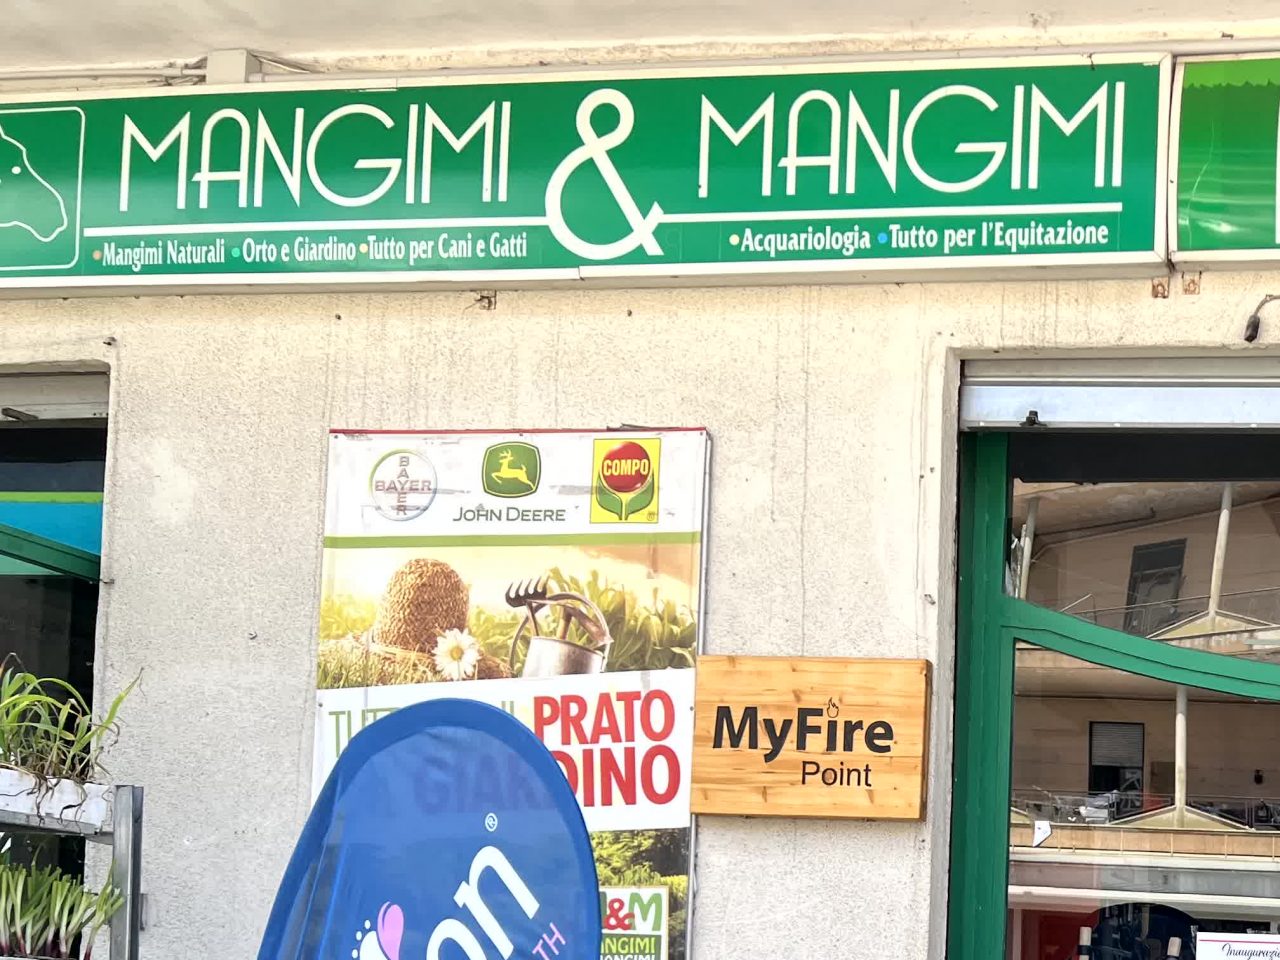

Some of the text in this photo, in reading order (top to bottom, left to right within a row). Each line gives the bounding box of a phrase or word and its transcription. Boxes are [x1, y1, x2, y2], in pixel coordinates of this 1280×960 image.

[119, 81, 1126, 261] MANGIMI & MANGIMI
[102, 231, 527, 272] Mangimi Naturali Orto e Giardino Tutto per Cani e Gatti
[740, 219, 1109, 257] Acquariologia Tutto per l'Equitazione
[375, 480, 432, 492] BAYER
[603, 458, 649, 477] COMPO
[453, 506, 566, 522] JOHN DEERE
[533, 689, 676, 745] PRATO
[713, 700, 894, 763] MyFire
[801, 761, 872, 787] Point
